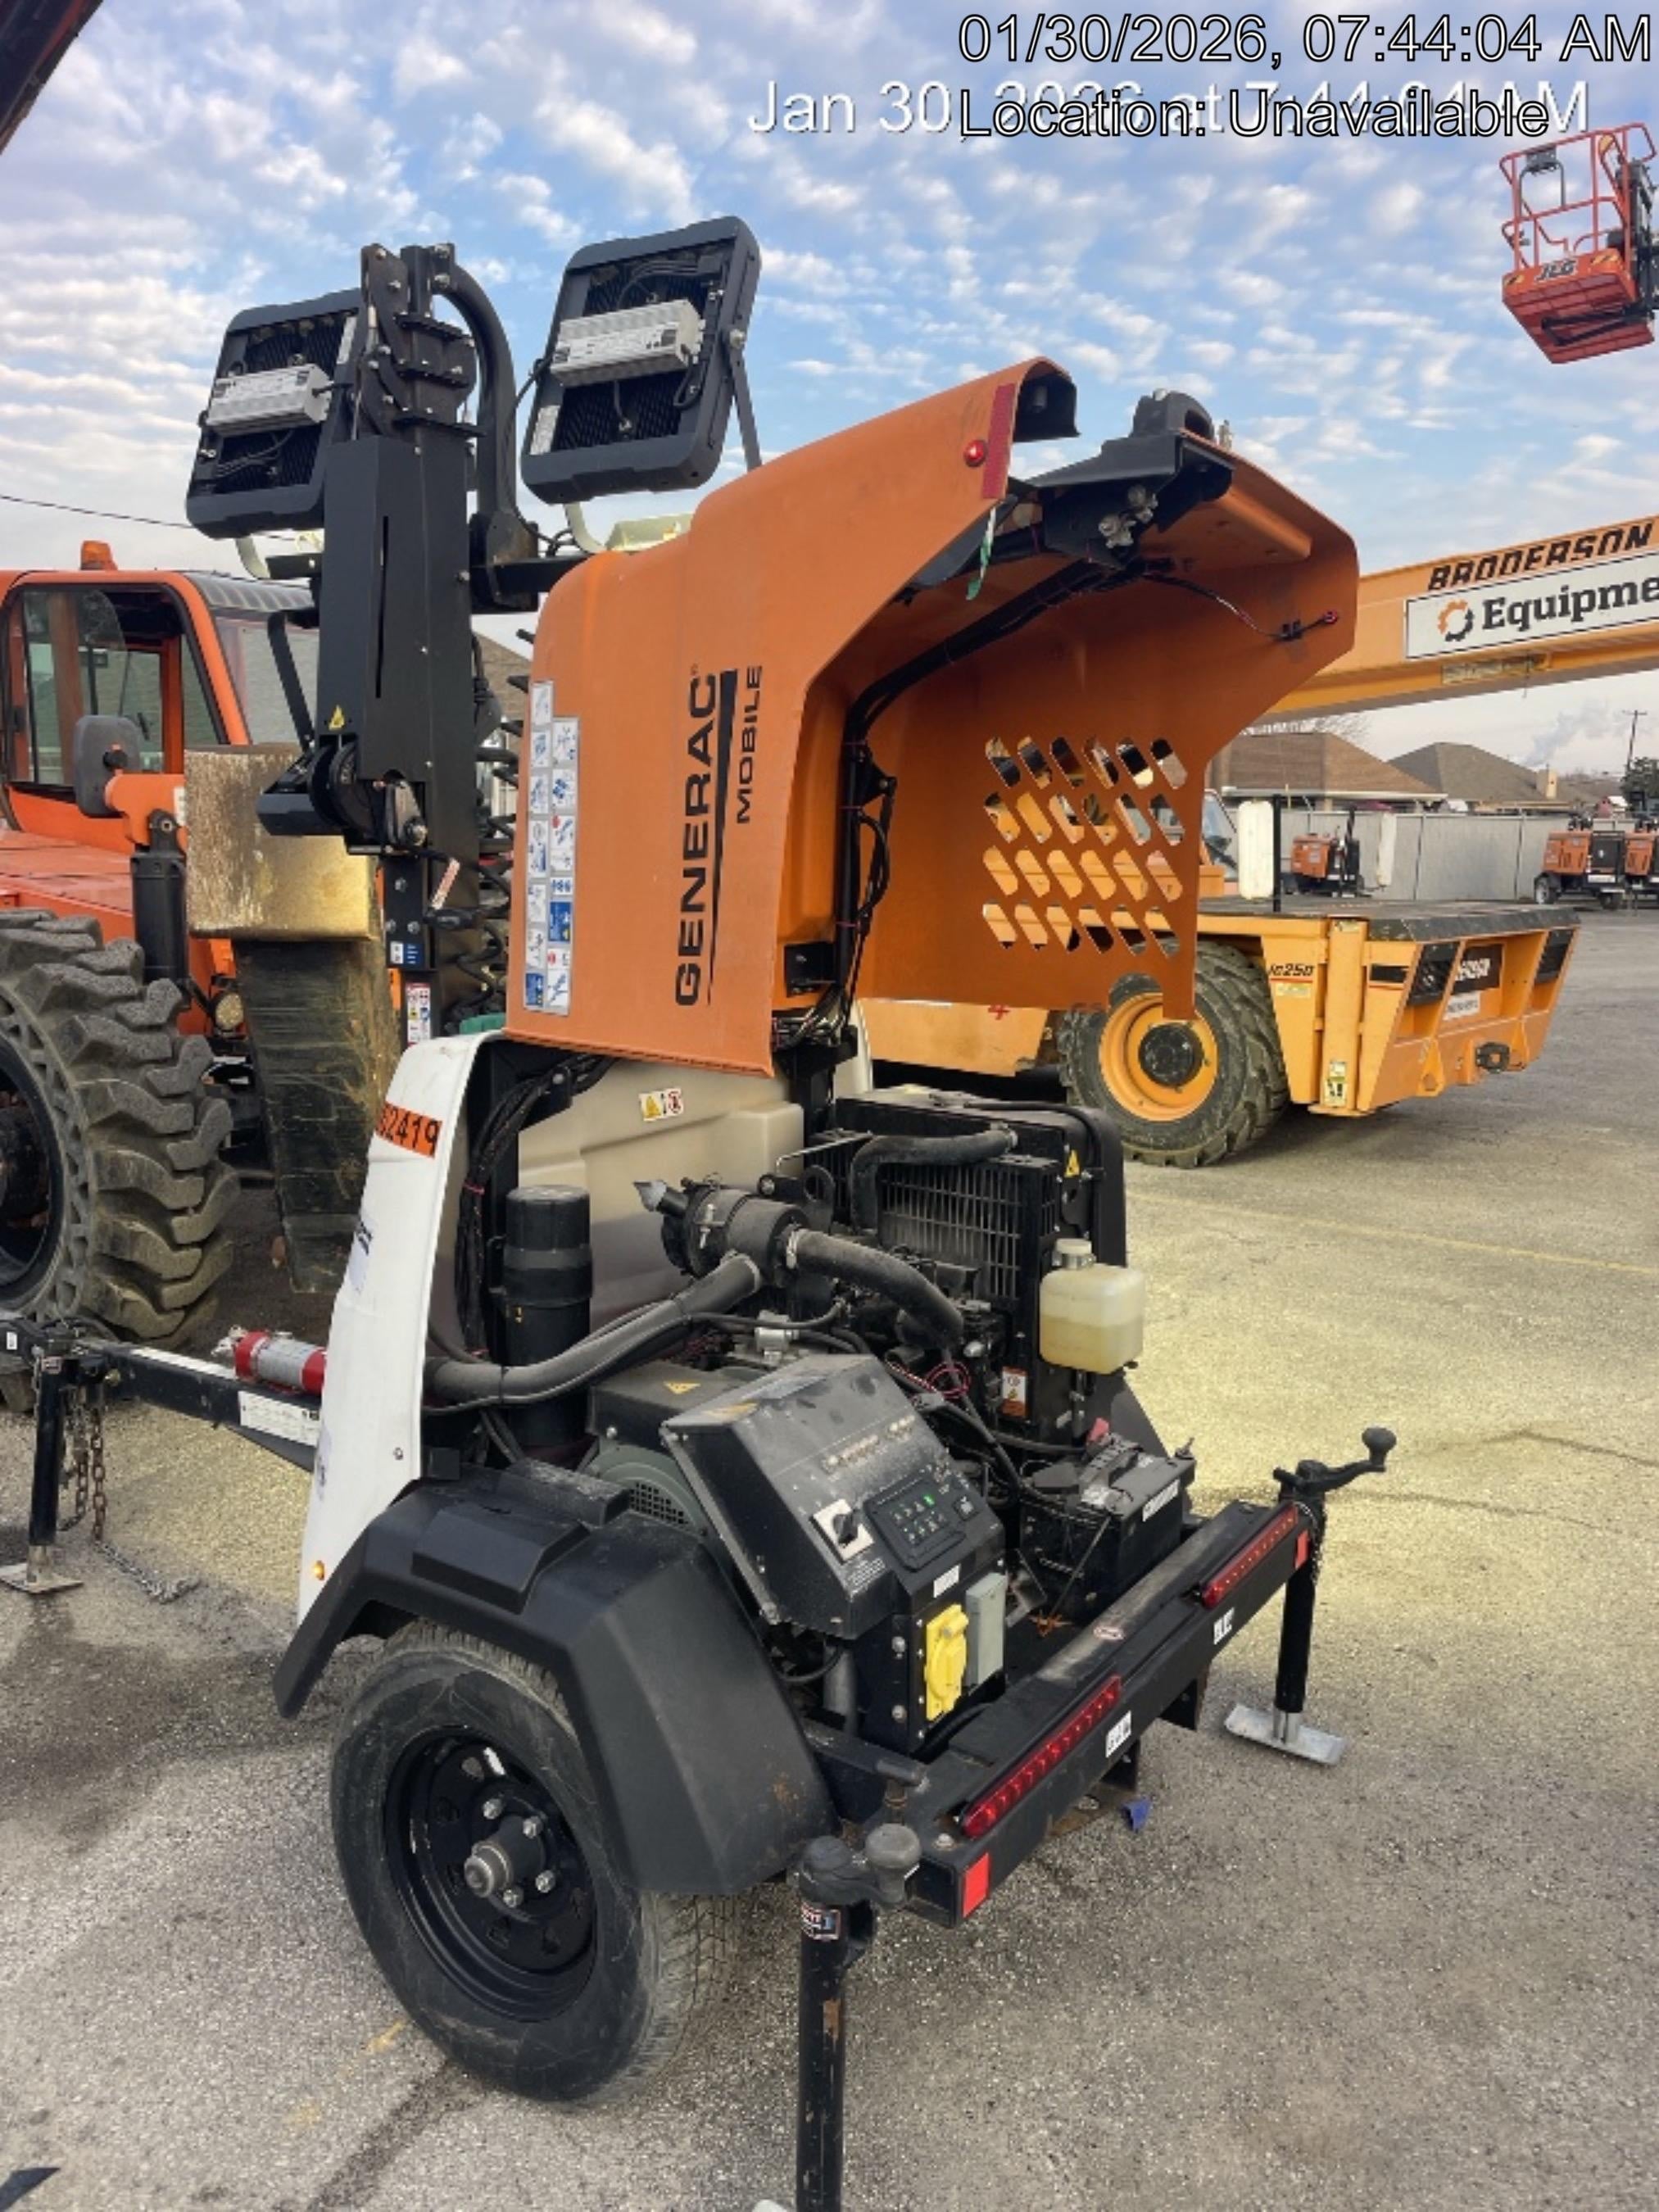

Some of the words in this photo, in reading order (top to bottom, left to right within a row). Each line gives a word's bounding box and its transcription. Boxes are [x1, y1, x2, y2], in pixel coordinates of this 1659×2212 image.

[1534, 258, 1578, 282] JLG
[1428, 523, 1653, 590] BRODERSON
[737, 665, 762, 824] MOBILE
[675, 672, 717, 1007] GENERAC
